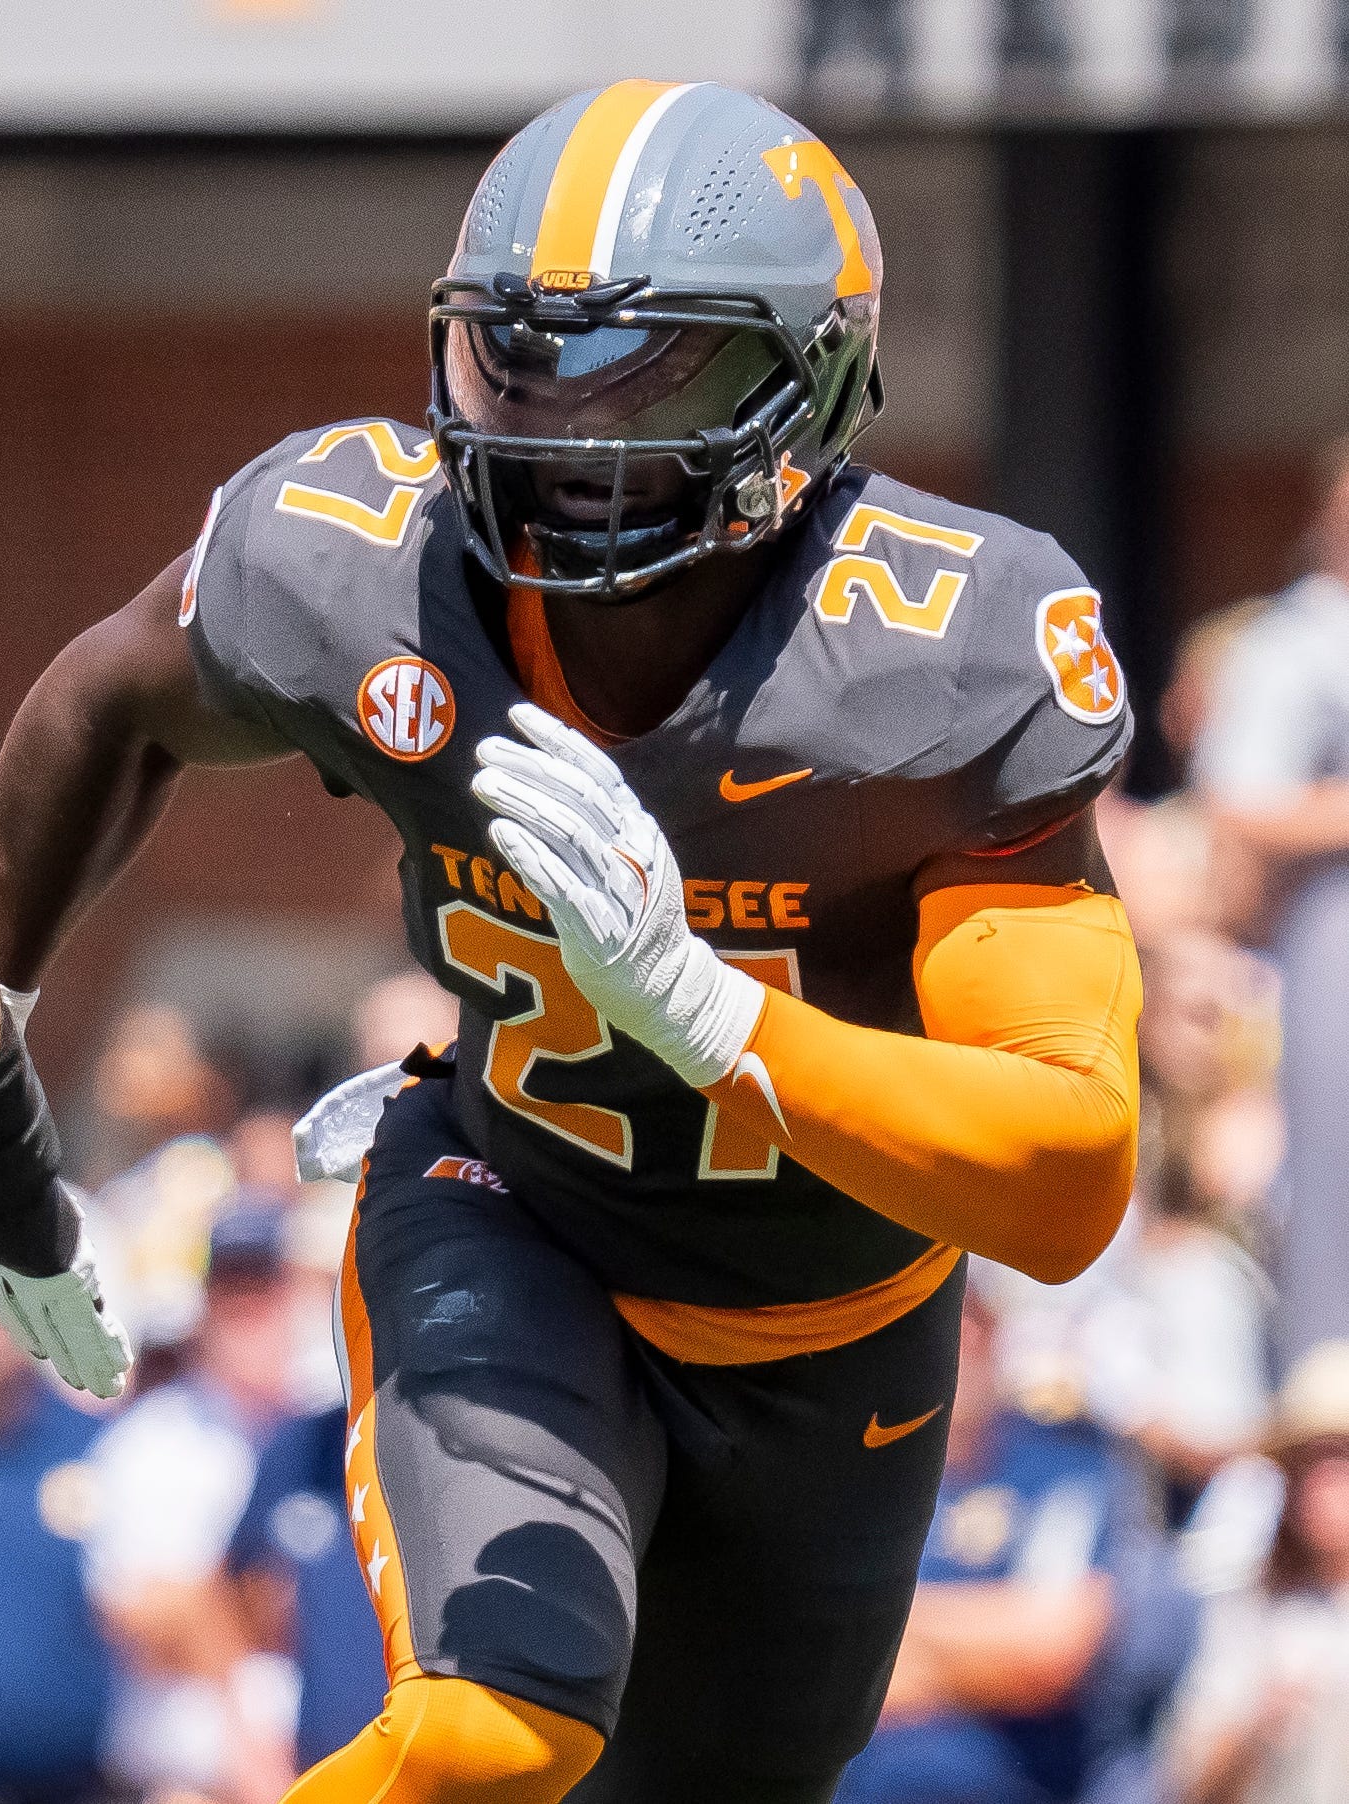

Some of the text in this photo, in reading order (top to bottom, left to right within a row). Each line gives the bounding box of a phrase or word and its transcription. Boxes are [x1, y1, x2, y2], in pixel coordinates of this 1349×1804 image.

[542, 271, 592, 291] VOLS
[275, 421, 443, 548] 27
[813, 502, 986, 640] 27
[367, 664, 447, 753] SEC
[431, 843, 811, 929] TENSEE
